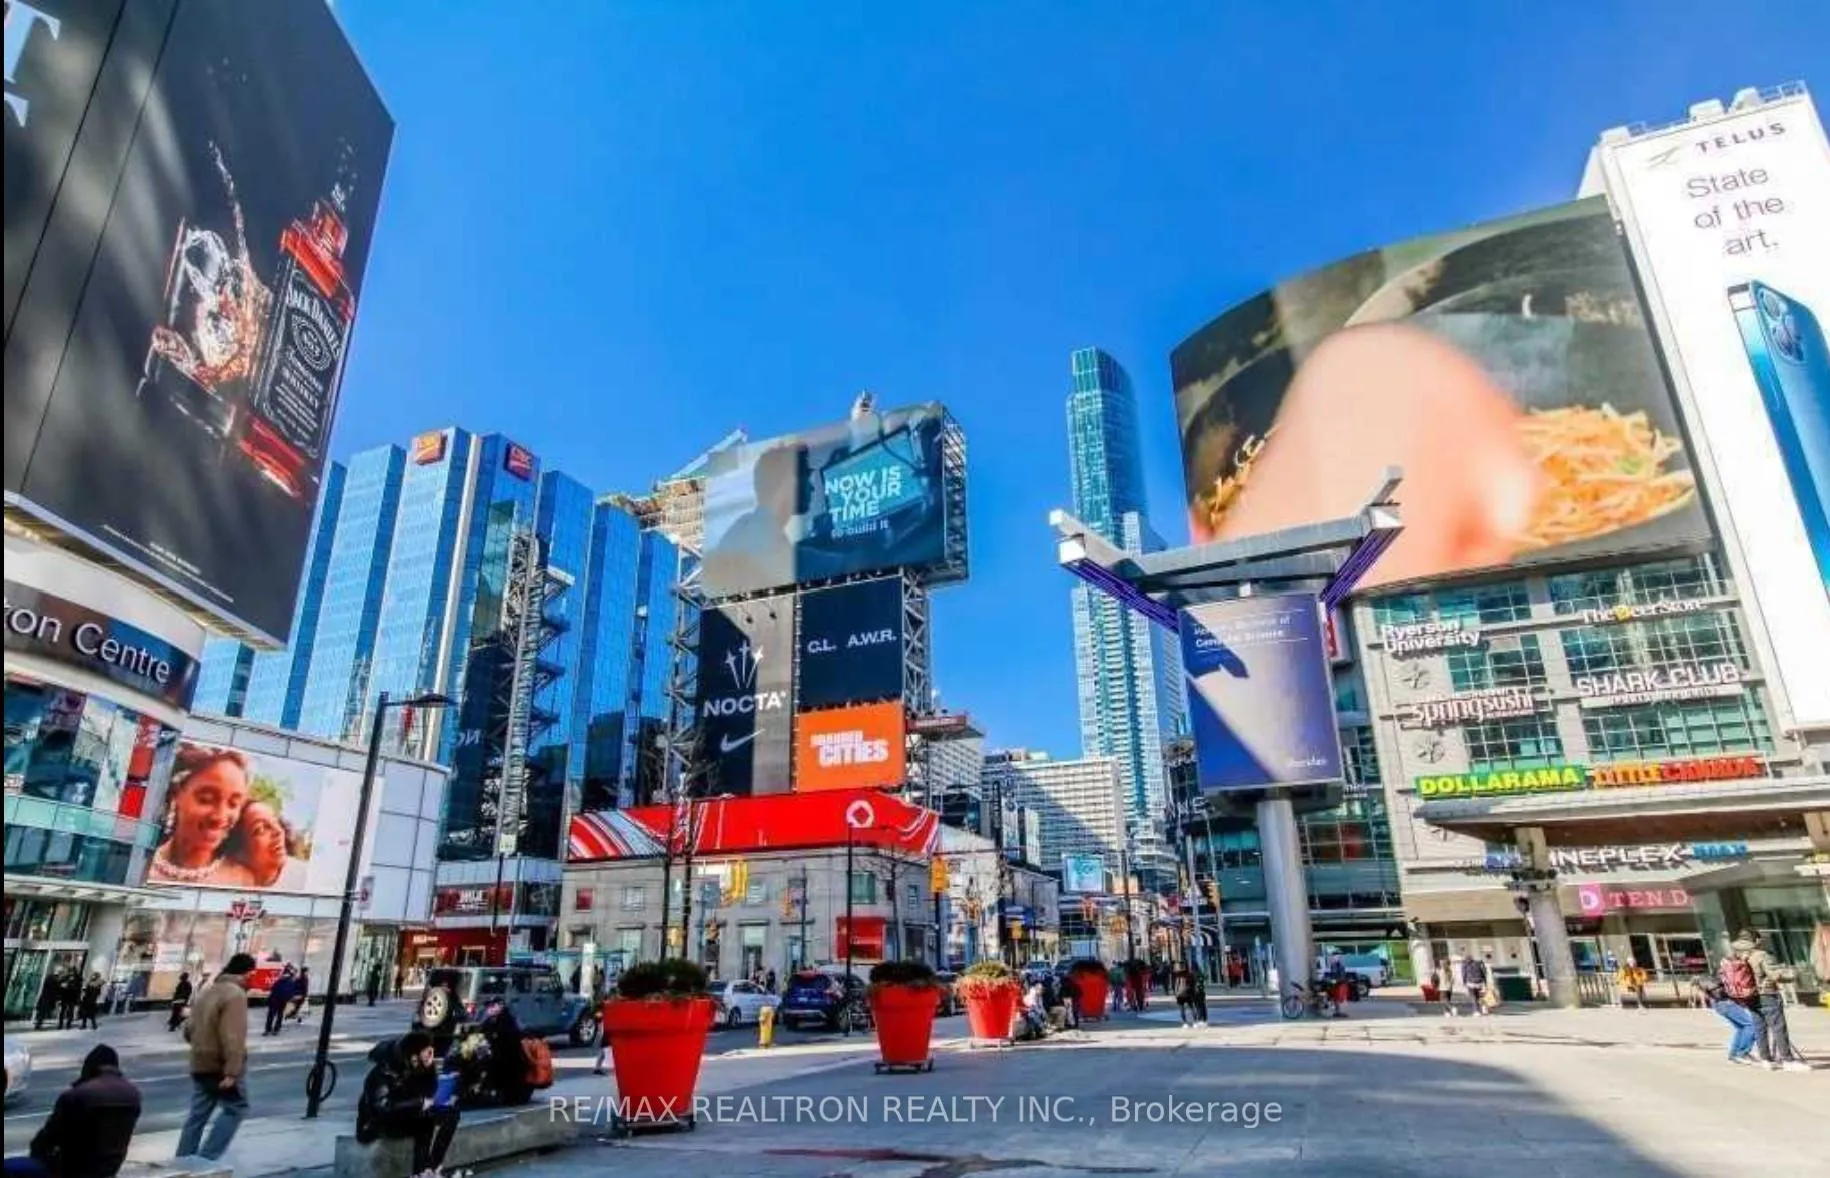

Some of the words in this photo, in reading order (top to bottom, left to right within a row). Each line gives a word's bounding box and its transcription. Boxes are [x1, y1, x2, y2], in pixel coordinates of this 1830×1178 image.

[1696, 122, 1786, 153] TELUS
[1686, 167, 1769, 198] State
[1694, 204, 1722, 229] of
[1733, 196, 1785, 222] the
[1722, 228, 1779, 255] art.
[825, 470, 876, 495] NOW
[881, 465, 901, 485] IS
[841, 481, 901, 504] YOUR
[828, 500, 880, 523] TIME
[848, 629, 897, 648] A.W.R.
[1382, 618, 1461, 642] Ryerson
[1384, 630, 1482, 656] University
[75, 622, 170, 684] Centre
[1577, 670, 1659, 697] SHARK
[1669, 662, 1740, 688] CLUB
[818, 740, 889, 767] CITIES
[1419, 767, 1582, 795] DOLLARAMA
